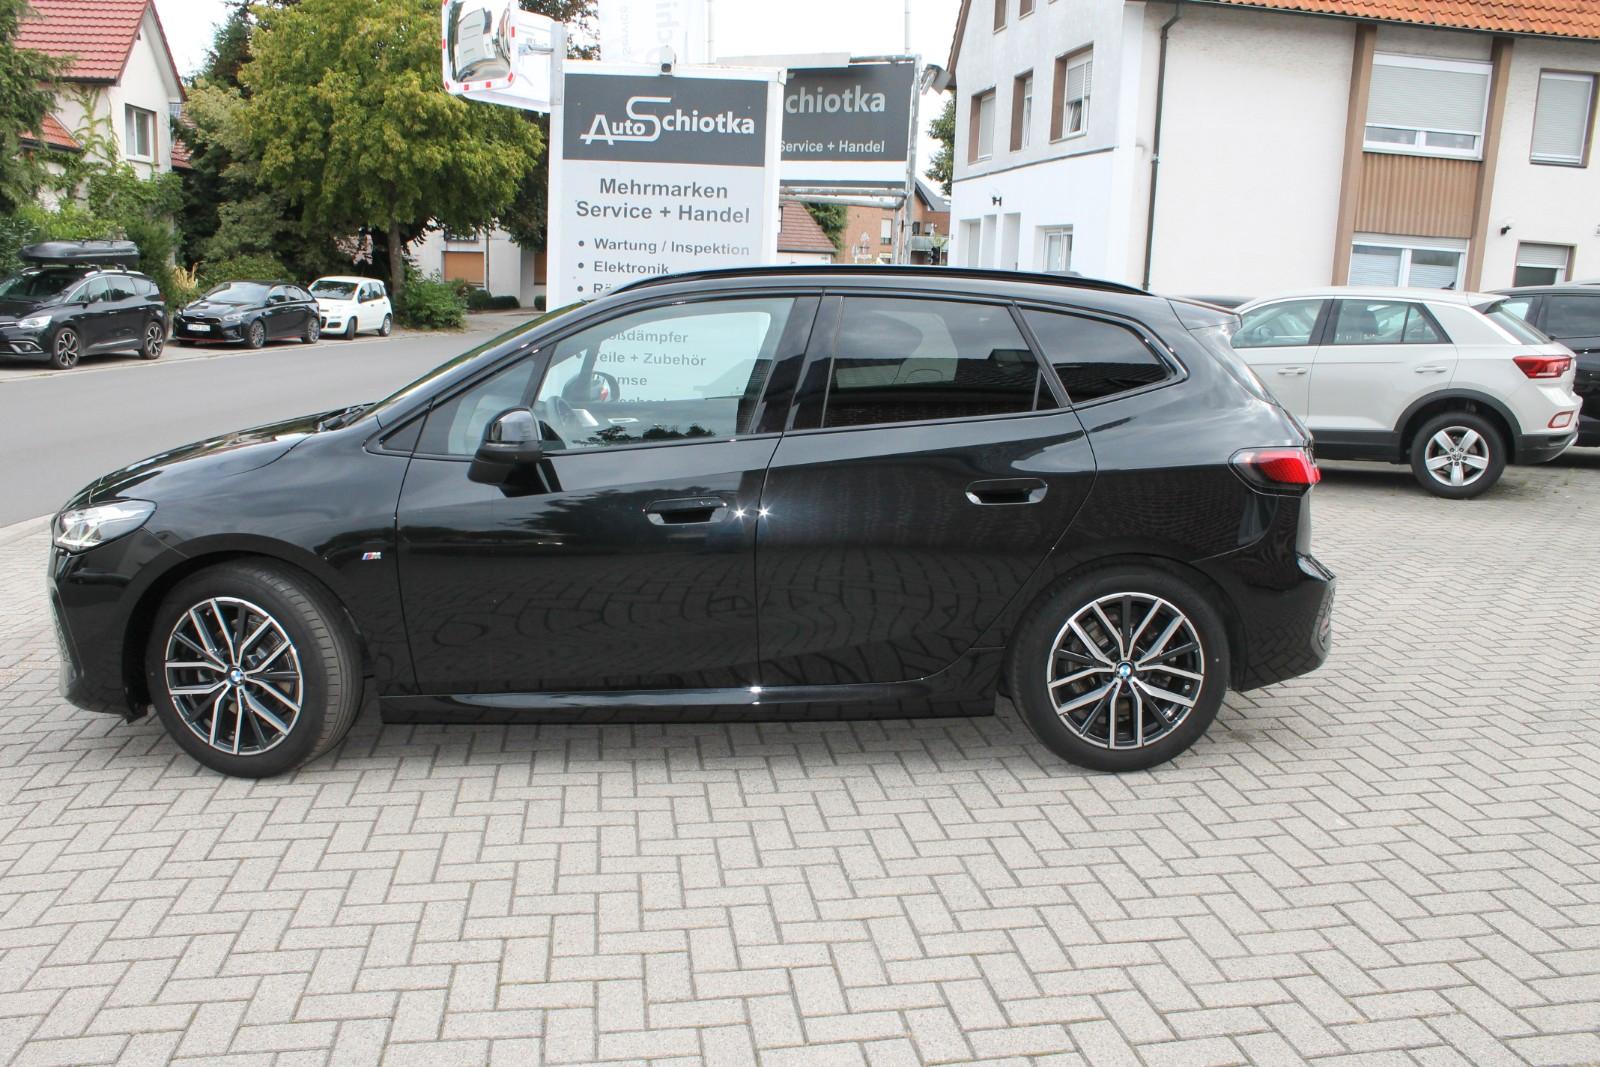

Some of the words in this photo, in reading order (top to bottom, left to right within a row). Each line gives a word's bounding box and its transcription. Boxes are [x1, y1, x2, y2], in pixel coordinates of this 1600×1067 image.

[785, 84, 886, 114] chiotka
[579, 114, 646, 145] Auto
[625, 95, 756, 142] Schiotka
[839, 140, 886, 153] Handel
[599, 177, 728, 199] Mehrmarken
[575, 201, 653, 219] Service
[659, 205, 672, 218] +
[678, 204, 751, 224] Handel
[593, 237, 658, 254] Wartung
[671, 241, 751, 257] Inspektion
[593, 260, 670, 276] Elektronik
[599, 352, 626, 363] eile
[643, 352, 708, 366] Zubehör
[617, 375, 648, 386] mse
